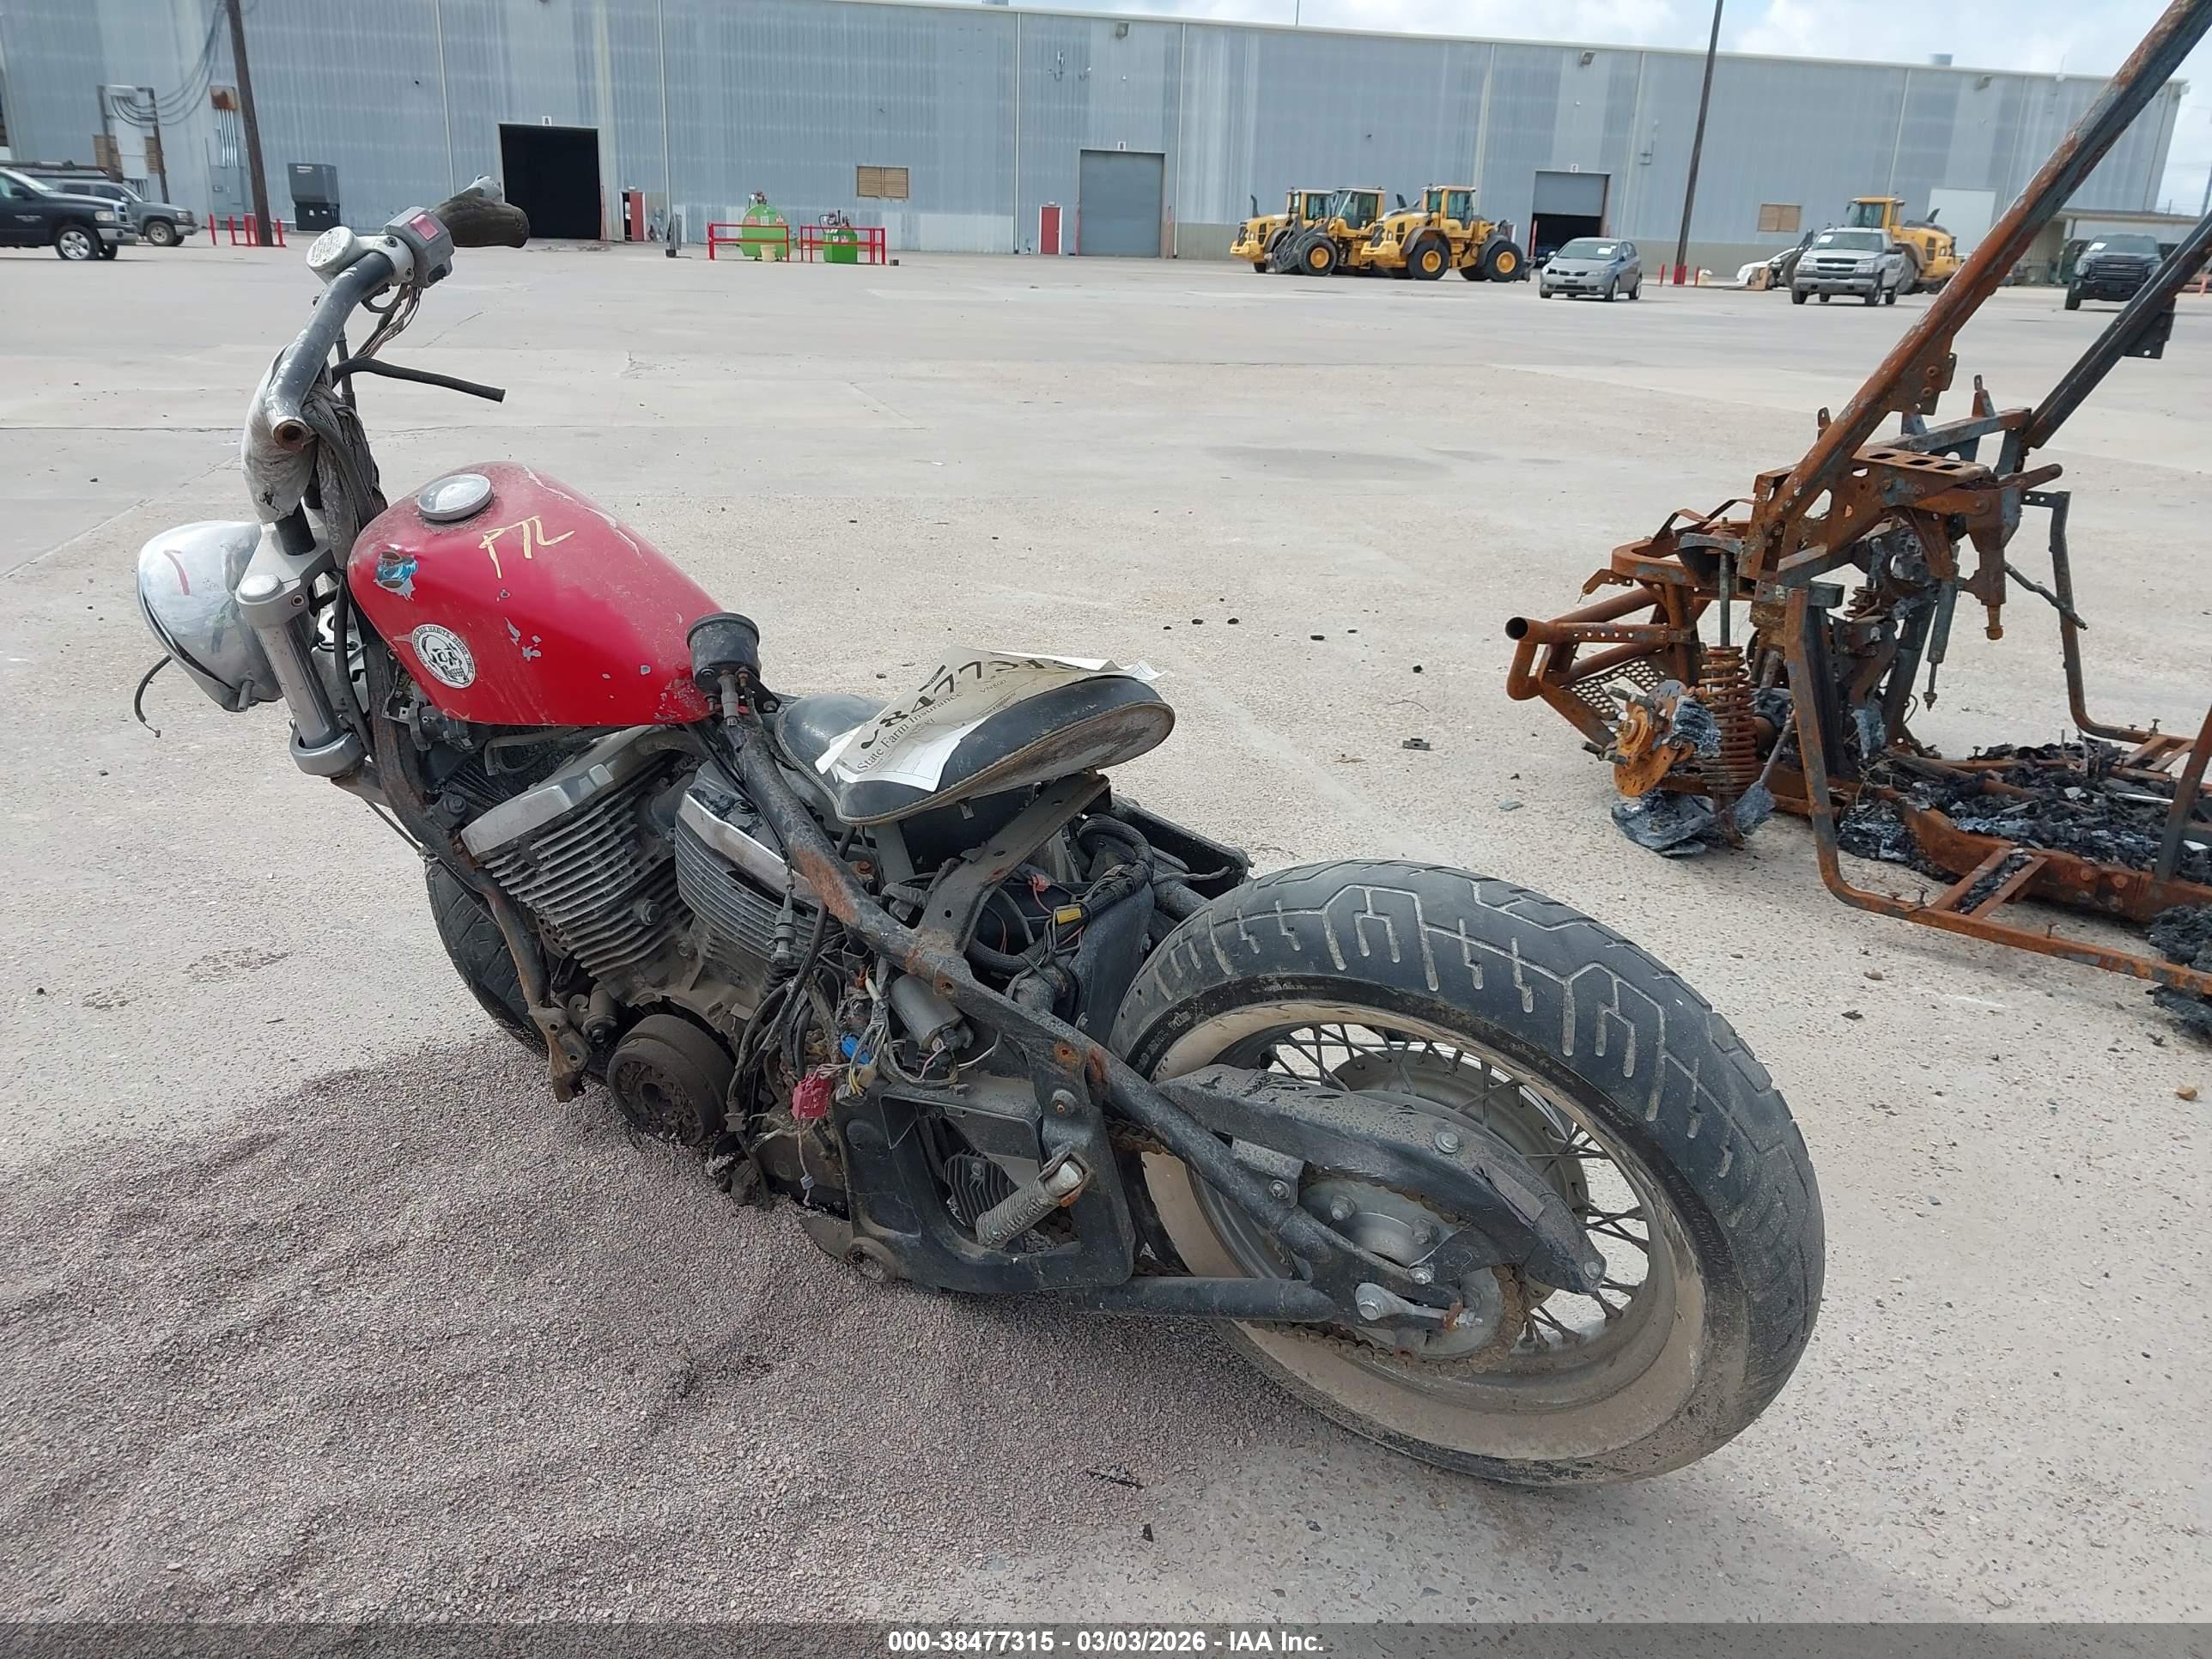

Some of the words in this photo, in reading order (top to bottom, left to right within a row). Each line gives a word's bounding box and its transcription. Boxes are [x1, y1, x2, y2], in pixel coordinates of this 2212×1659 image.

[857, 748, 884, 773] State
[880, 723, 909, 748] Farm
[908, 691, 963, 723] Insurance
